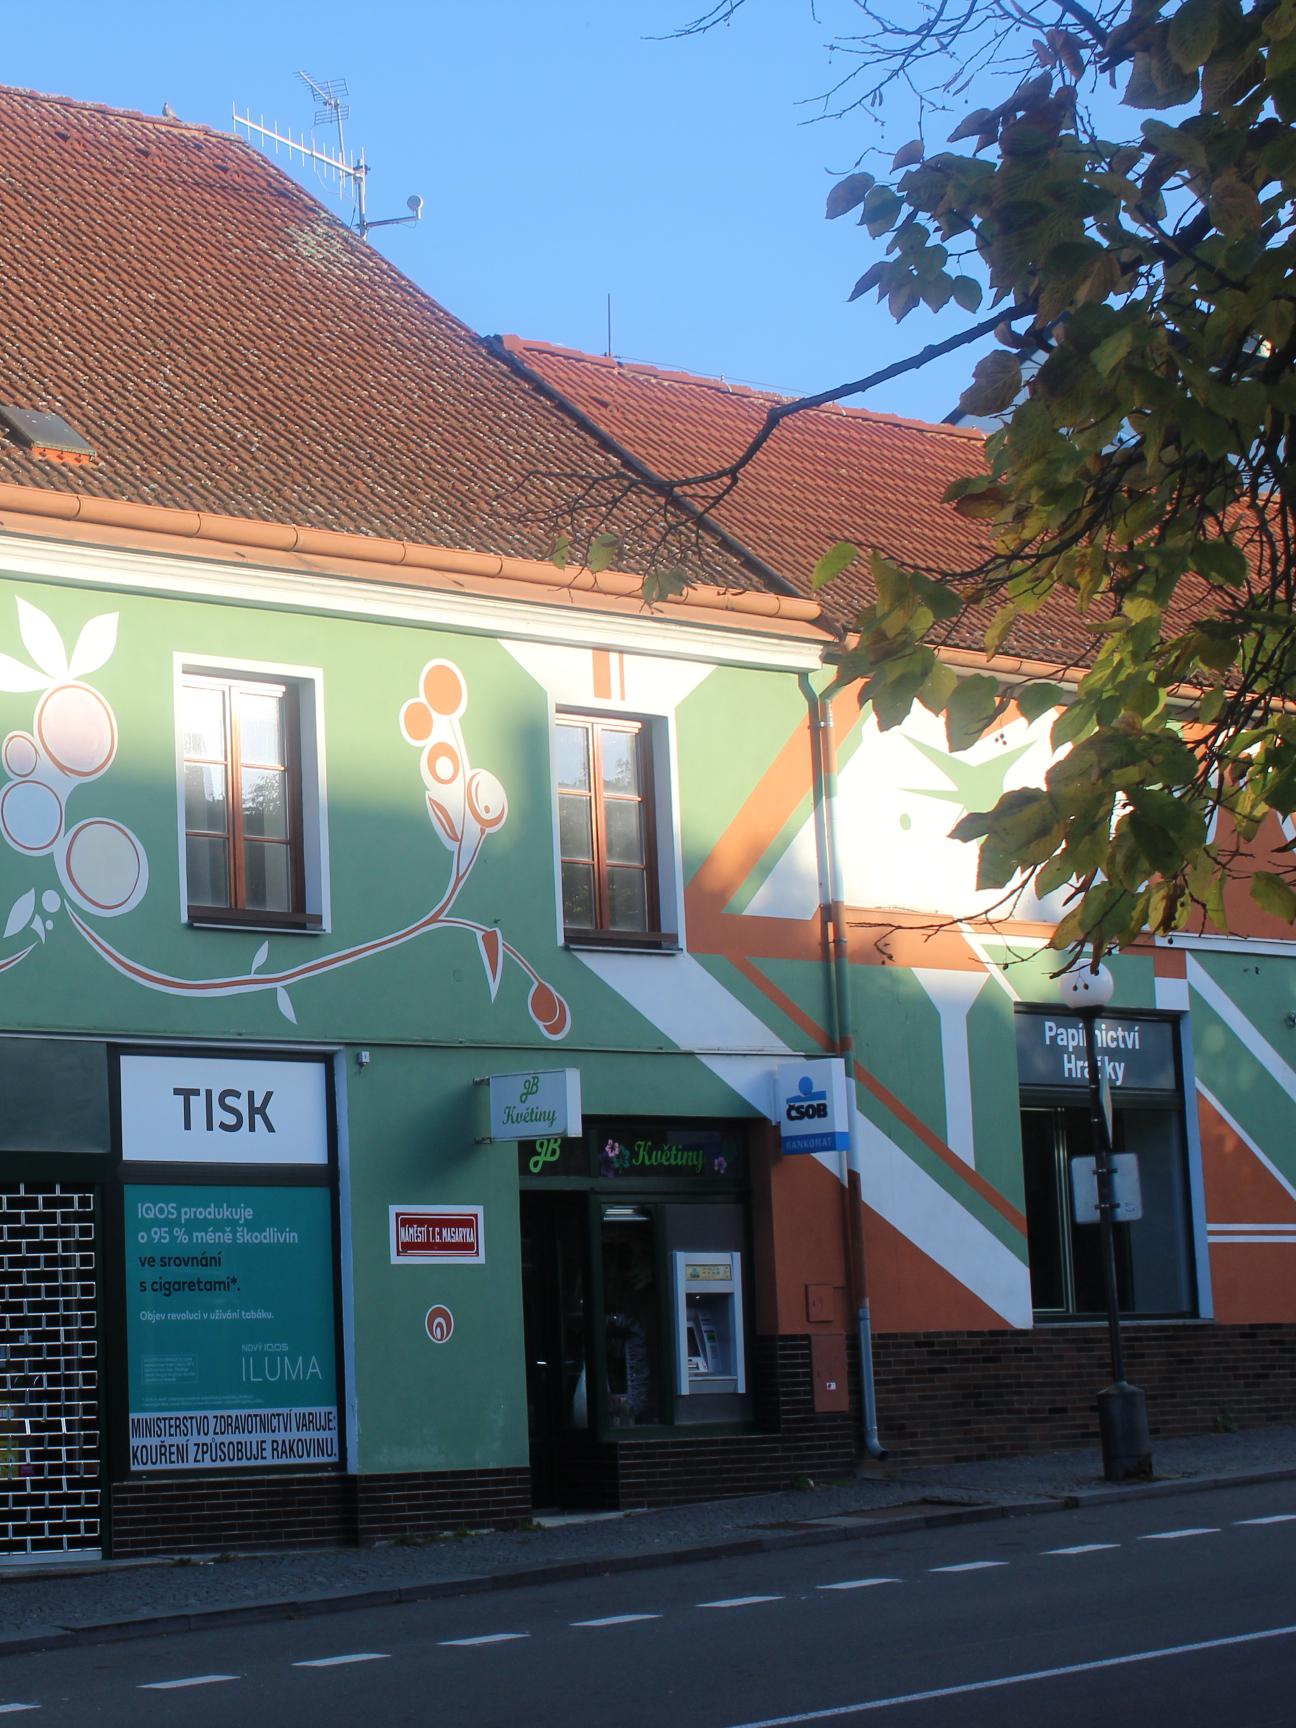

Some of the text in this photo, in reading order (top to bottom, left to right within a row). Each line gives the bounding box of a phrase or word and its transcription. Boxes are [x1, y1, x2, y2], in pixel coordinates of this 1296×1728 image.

[173, 1087, 276, 1134] TISK
[502, 1105, 557, 1128] Květiny
[786, 1103, 828, 1121] ČSOB
[632, 1140, 704, 1173] Květiny
[137, 1203, 253, 1224] IQOS produkuje
[138, 1226, 299, 1244] o 95 % méně škodlivin
[399, 1224, 427, 1243] NÁMĚSTÍ
[442, 1227, 475, 1243] MASARYKA
[138, 1251, 223, 1268] ve srovnání
[139, 1281, 147, 1293] s
[139, 1311, 166, 1323] Objev
[167, 1310, 201, 1321] revoluci
[202, 1312, 208, 1320] v
[241, 1309, 275, 1320] tabáku.
[241, 1342, 289, 1352] NOVÝ IQOS
[242, 1355, 323, 1382] ILUMA
[131, 1409, 336, 1439] MINISTERSTVO ZDRAVOTNICTVÍ VARUJE:
[131, 1437, 337, 1466] KOUŘENÍ ZPŮSOBUJE RAKOVINU.
